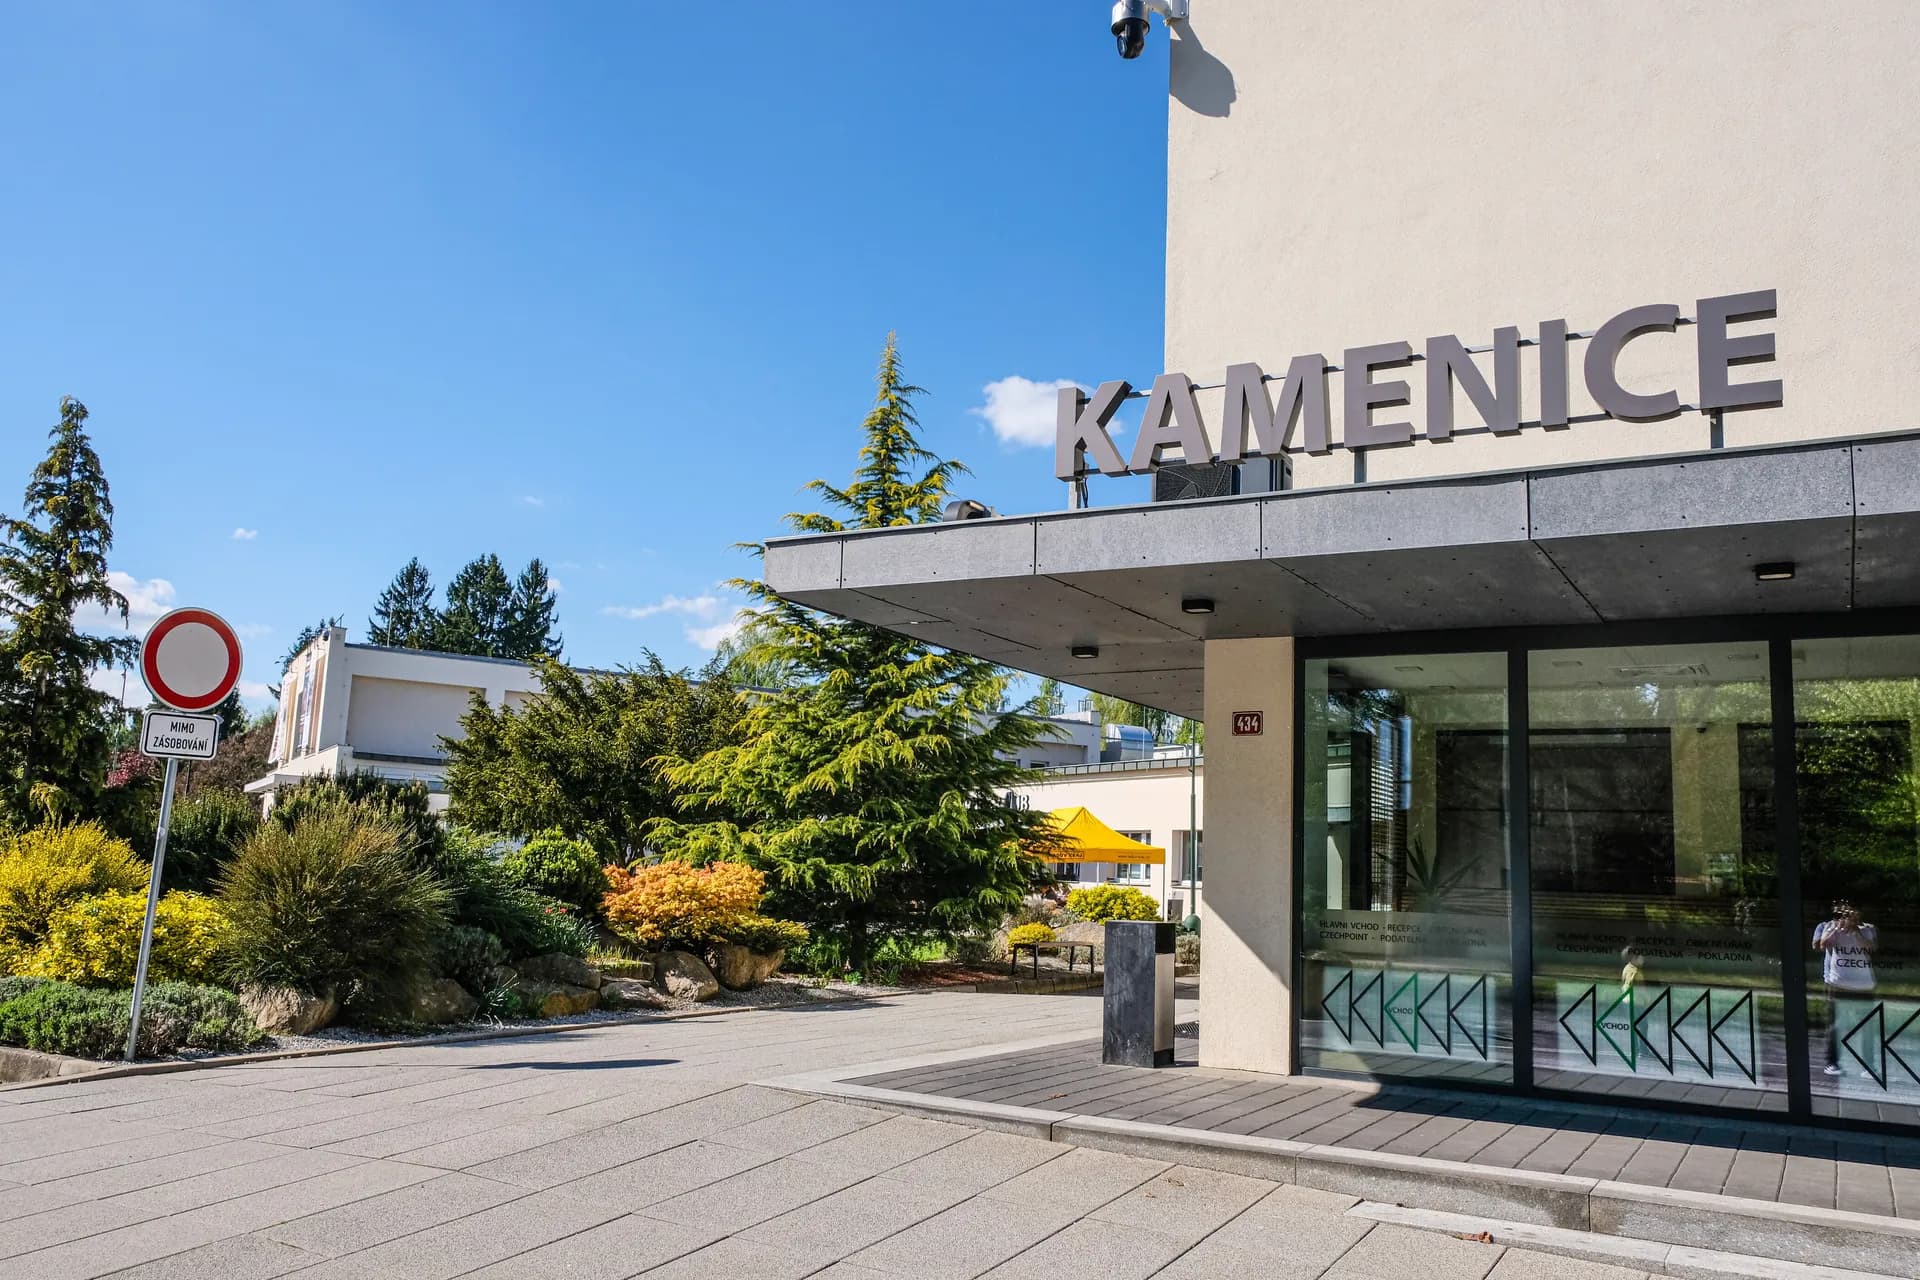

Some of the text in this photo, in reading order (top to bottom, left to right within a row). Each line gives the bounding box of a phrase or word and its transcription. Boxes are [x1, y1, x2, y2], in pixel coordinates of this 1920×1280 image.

[1055, 288, 1784, 482] KAMENICE
[170, 721, 195, 734] MIMO
[1237, 716, 1259, 731] 434
[153, 735, 209, 751] ZÁSOBOVÁNÍ
[1351, 922, 1379, 931] VCHOD
[1320, 931, 1368, 940] CZECHPOINT
[1628, 947, 1684, 958] PODATELNA
[1698, 951, 1753, 962] POKLADNA
[1388, 1007, 1413, 1015] VCHOD
[1601, 1022, 1629, 1031] VCHOD
